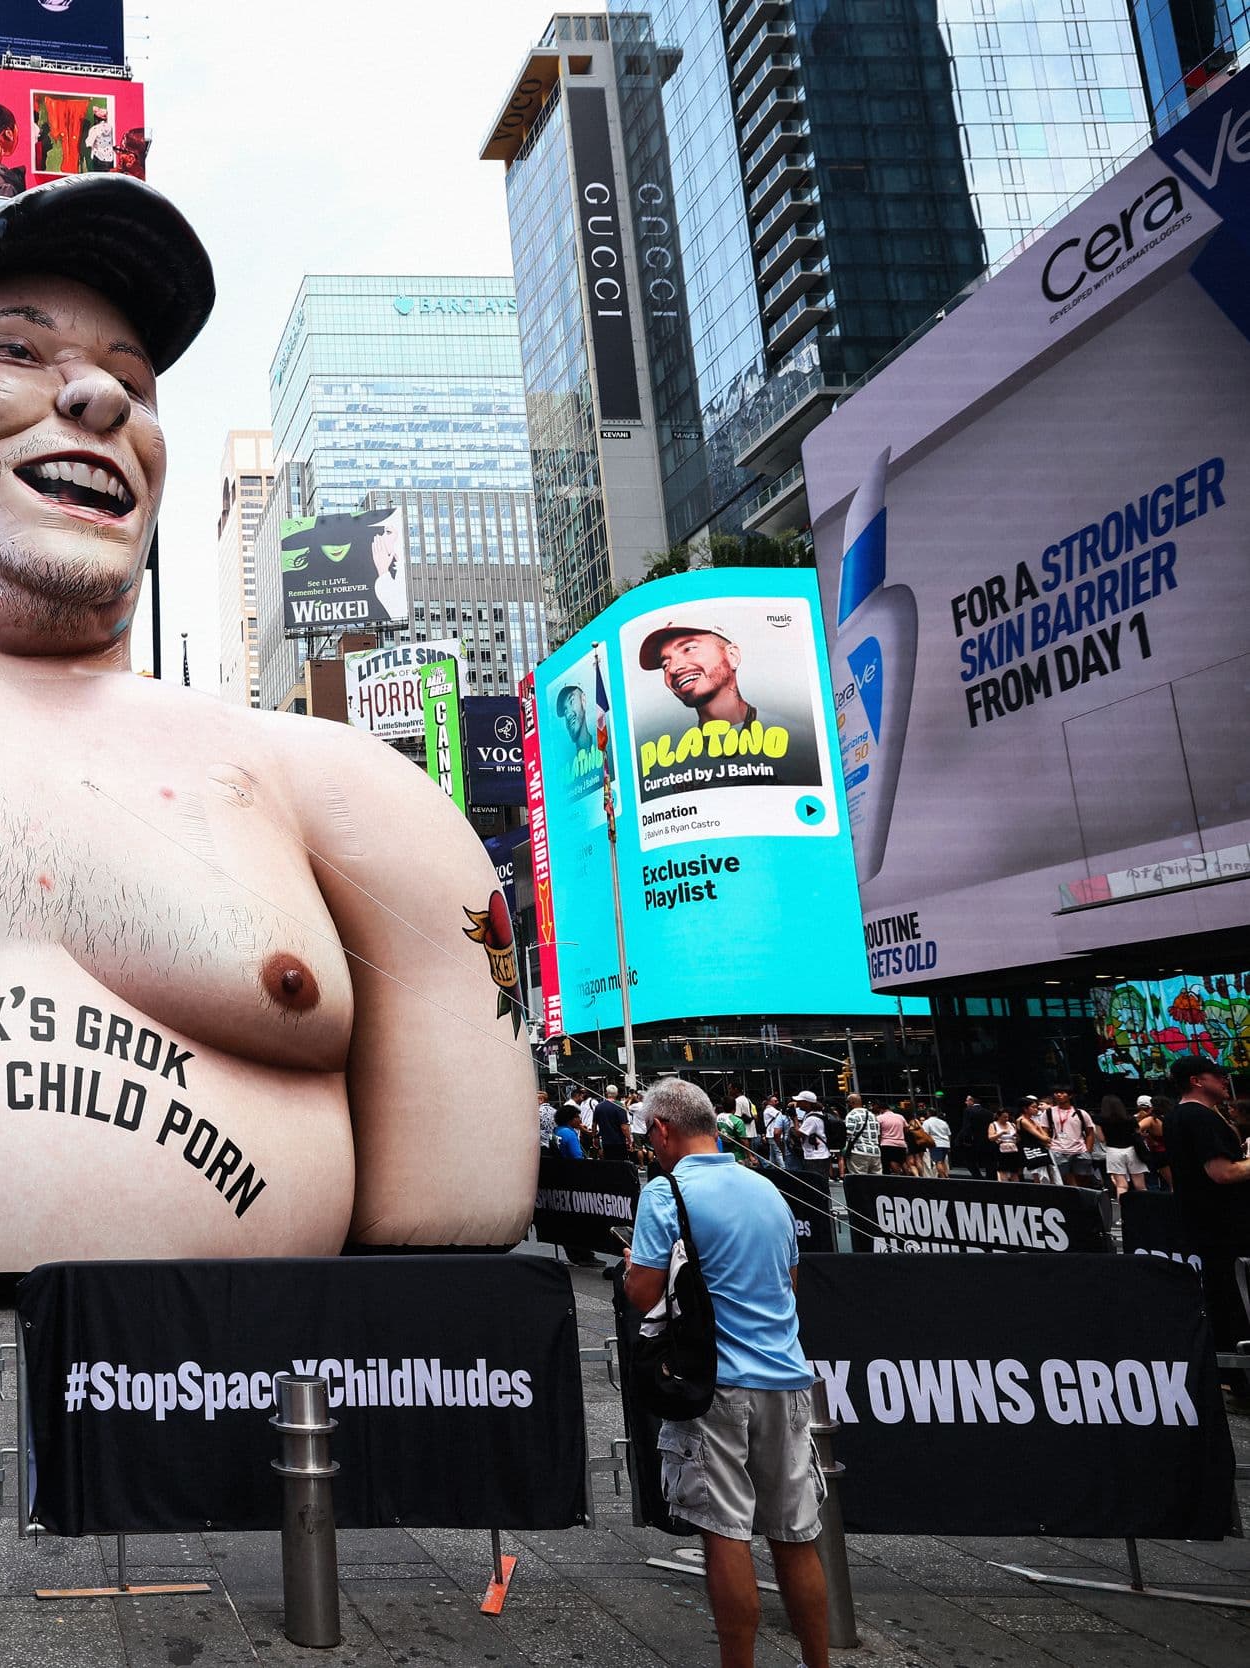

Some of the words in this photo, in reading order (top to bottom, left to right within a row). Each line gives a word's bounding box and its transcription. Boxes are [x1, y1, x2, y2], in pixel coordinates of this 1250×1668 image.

[584, 182, 623, 317] GUCCI
[1049, 287, 1093, 325] DEVELOPED
[1093, 271, 1115, 291] WITH
[1115, 212, 1193, 275] DERMATOLOGISTS
[420, 298, 517, 315] BARCLAYS
[950, 574, 1010, 638] FOR
[1014, 561, 1040, 608] A
[1040, 456, 1226, 593] STRONGER
[288, 588, 324, 597] Remember
[960, 612, 1025, 682] SKIN
[1031, 541, 1178, 652] BARRIER
[766, 613, 792, 623] music
[357, 648, 412, 682] LITTLE
[965, 654, 1052, 728] FROM
[1054, 621, 1121, 692] DAY
[1129, 611, 1152, 660] 1
[640, 720, 789, 778] PLATINO
[855, 743, 869, 762] 50
[644, 768, 693, 792] Curated
[695, 768, 713, 781] by
[716, 765, 726, 778] J
[728, 762, 774, 777] Balvin
[642, 805, 697, 827] Dalmation
[670, 823, 690, 834] Ryan
[691, 820, 721, 830] Castro
[531, 805, 549, 881] INSIDE!
[642, 854, 740, 887] Exclusive
[644, 880, 717, 911] Playlist
[871, 947, 902, 979] GETS
[905, 941, 937, 972] OLD
[578, 975, 607, 996] mazon
[608, 966, 639, 991] muic
[77, 1004, 195, 1090] GROK
[6, 1061, 147, 1132] CHILD
[155, 1099, 267, 1219] PORN
[535, 1188, 571, 1212] SPACEX
[572, 1191, 604, 1216] OWNS
[603, 1194, 633, 1220] GROK
[875, 1195, 952, 1240] GROK
[954, 1201, 1069, 1252] MAKES
[65, 1358, 532, 1420] #StopSpacChildNudes
[866, 1358, 1036, 1425] OWNS
[1040, 1358, 1199, 1427] GROK
